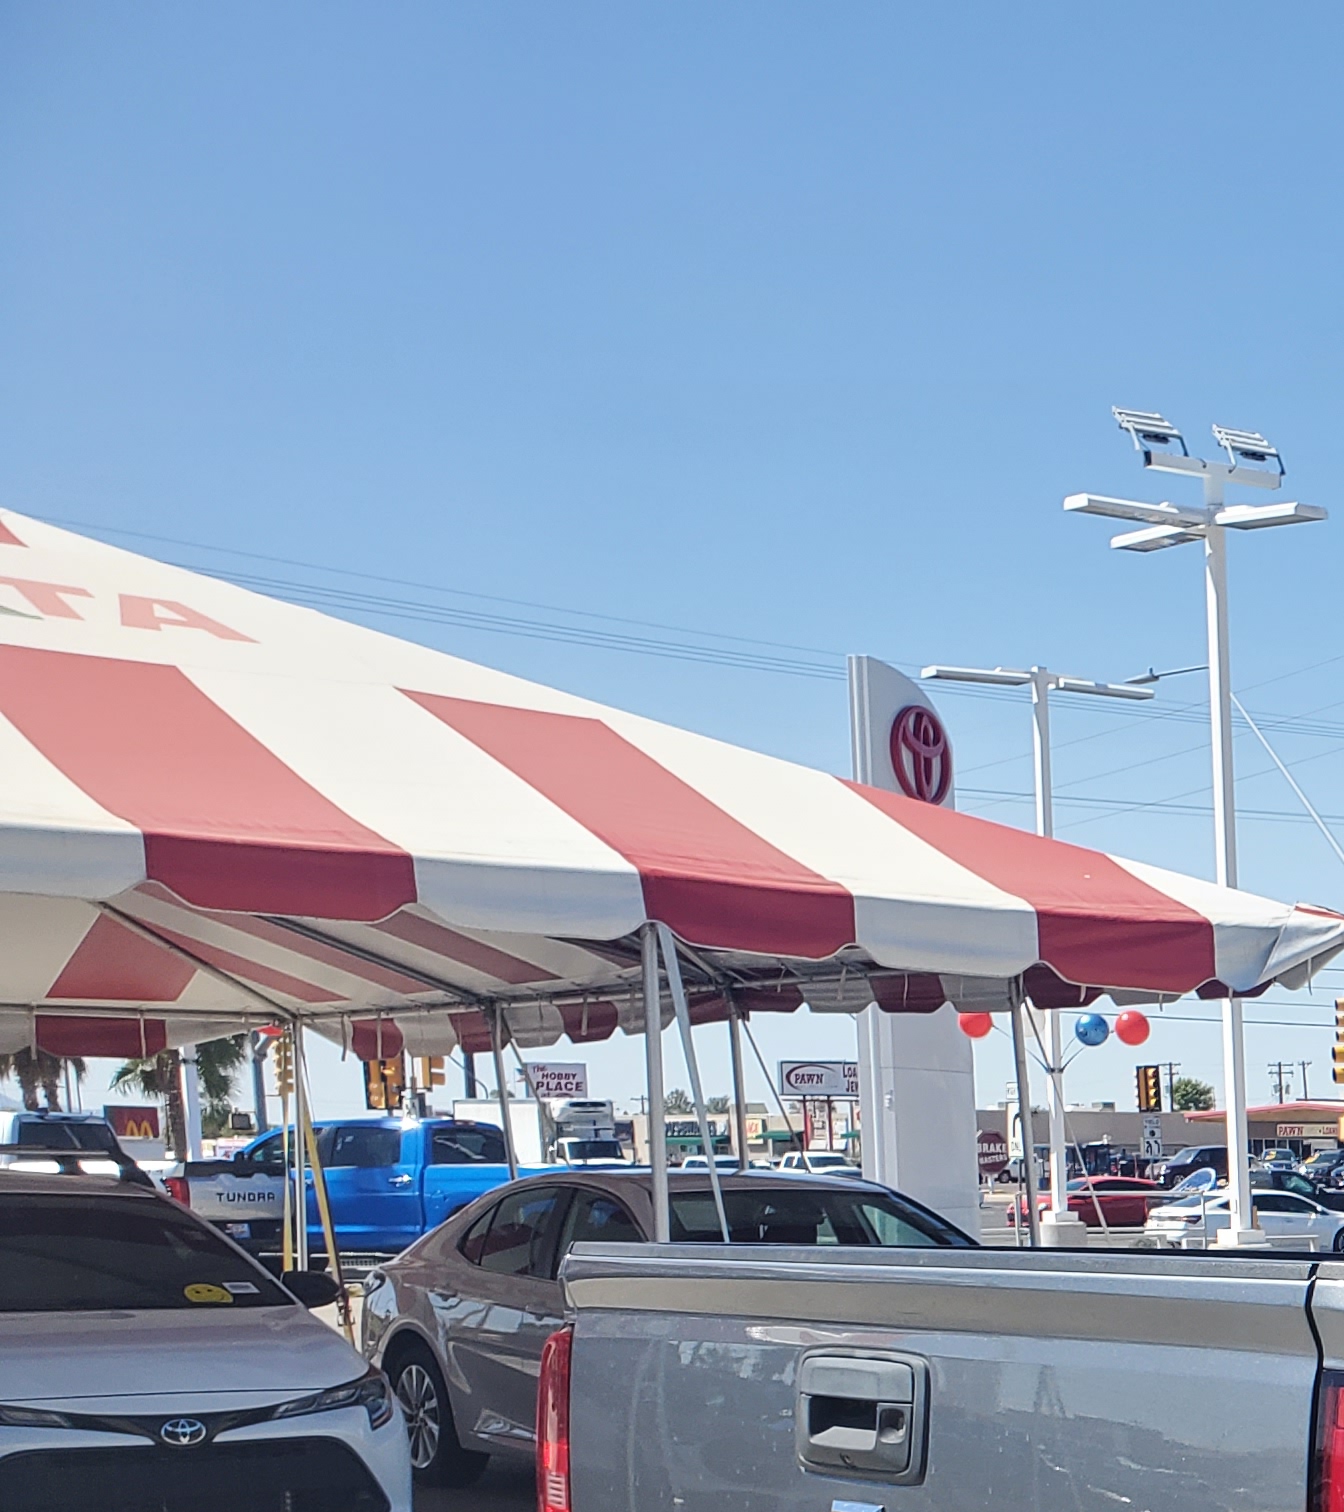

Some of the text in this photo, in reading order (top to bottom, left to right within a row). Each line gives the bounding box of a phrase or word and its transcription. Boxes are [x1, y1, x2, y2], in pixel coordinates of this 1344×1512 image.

[541, 1072, 577, 1080] HOBBY
[795, 1074, 824, 1084] PAWN
[536, 1081, 583, 1091] PLACE
[1279, 1126, 1303, 1136] PAWN
[978, 1143, 1007, 1153] BRAKE
[216, 1192, 276, 1202] TUNDRA
